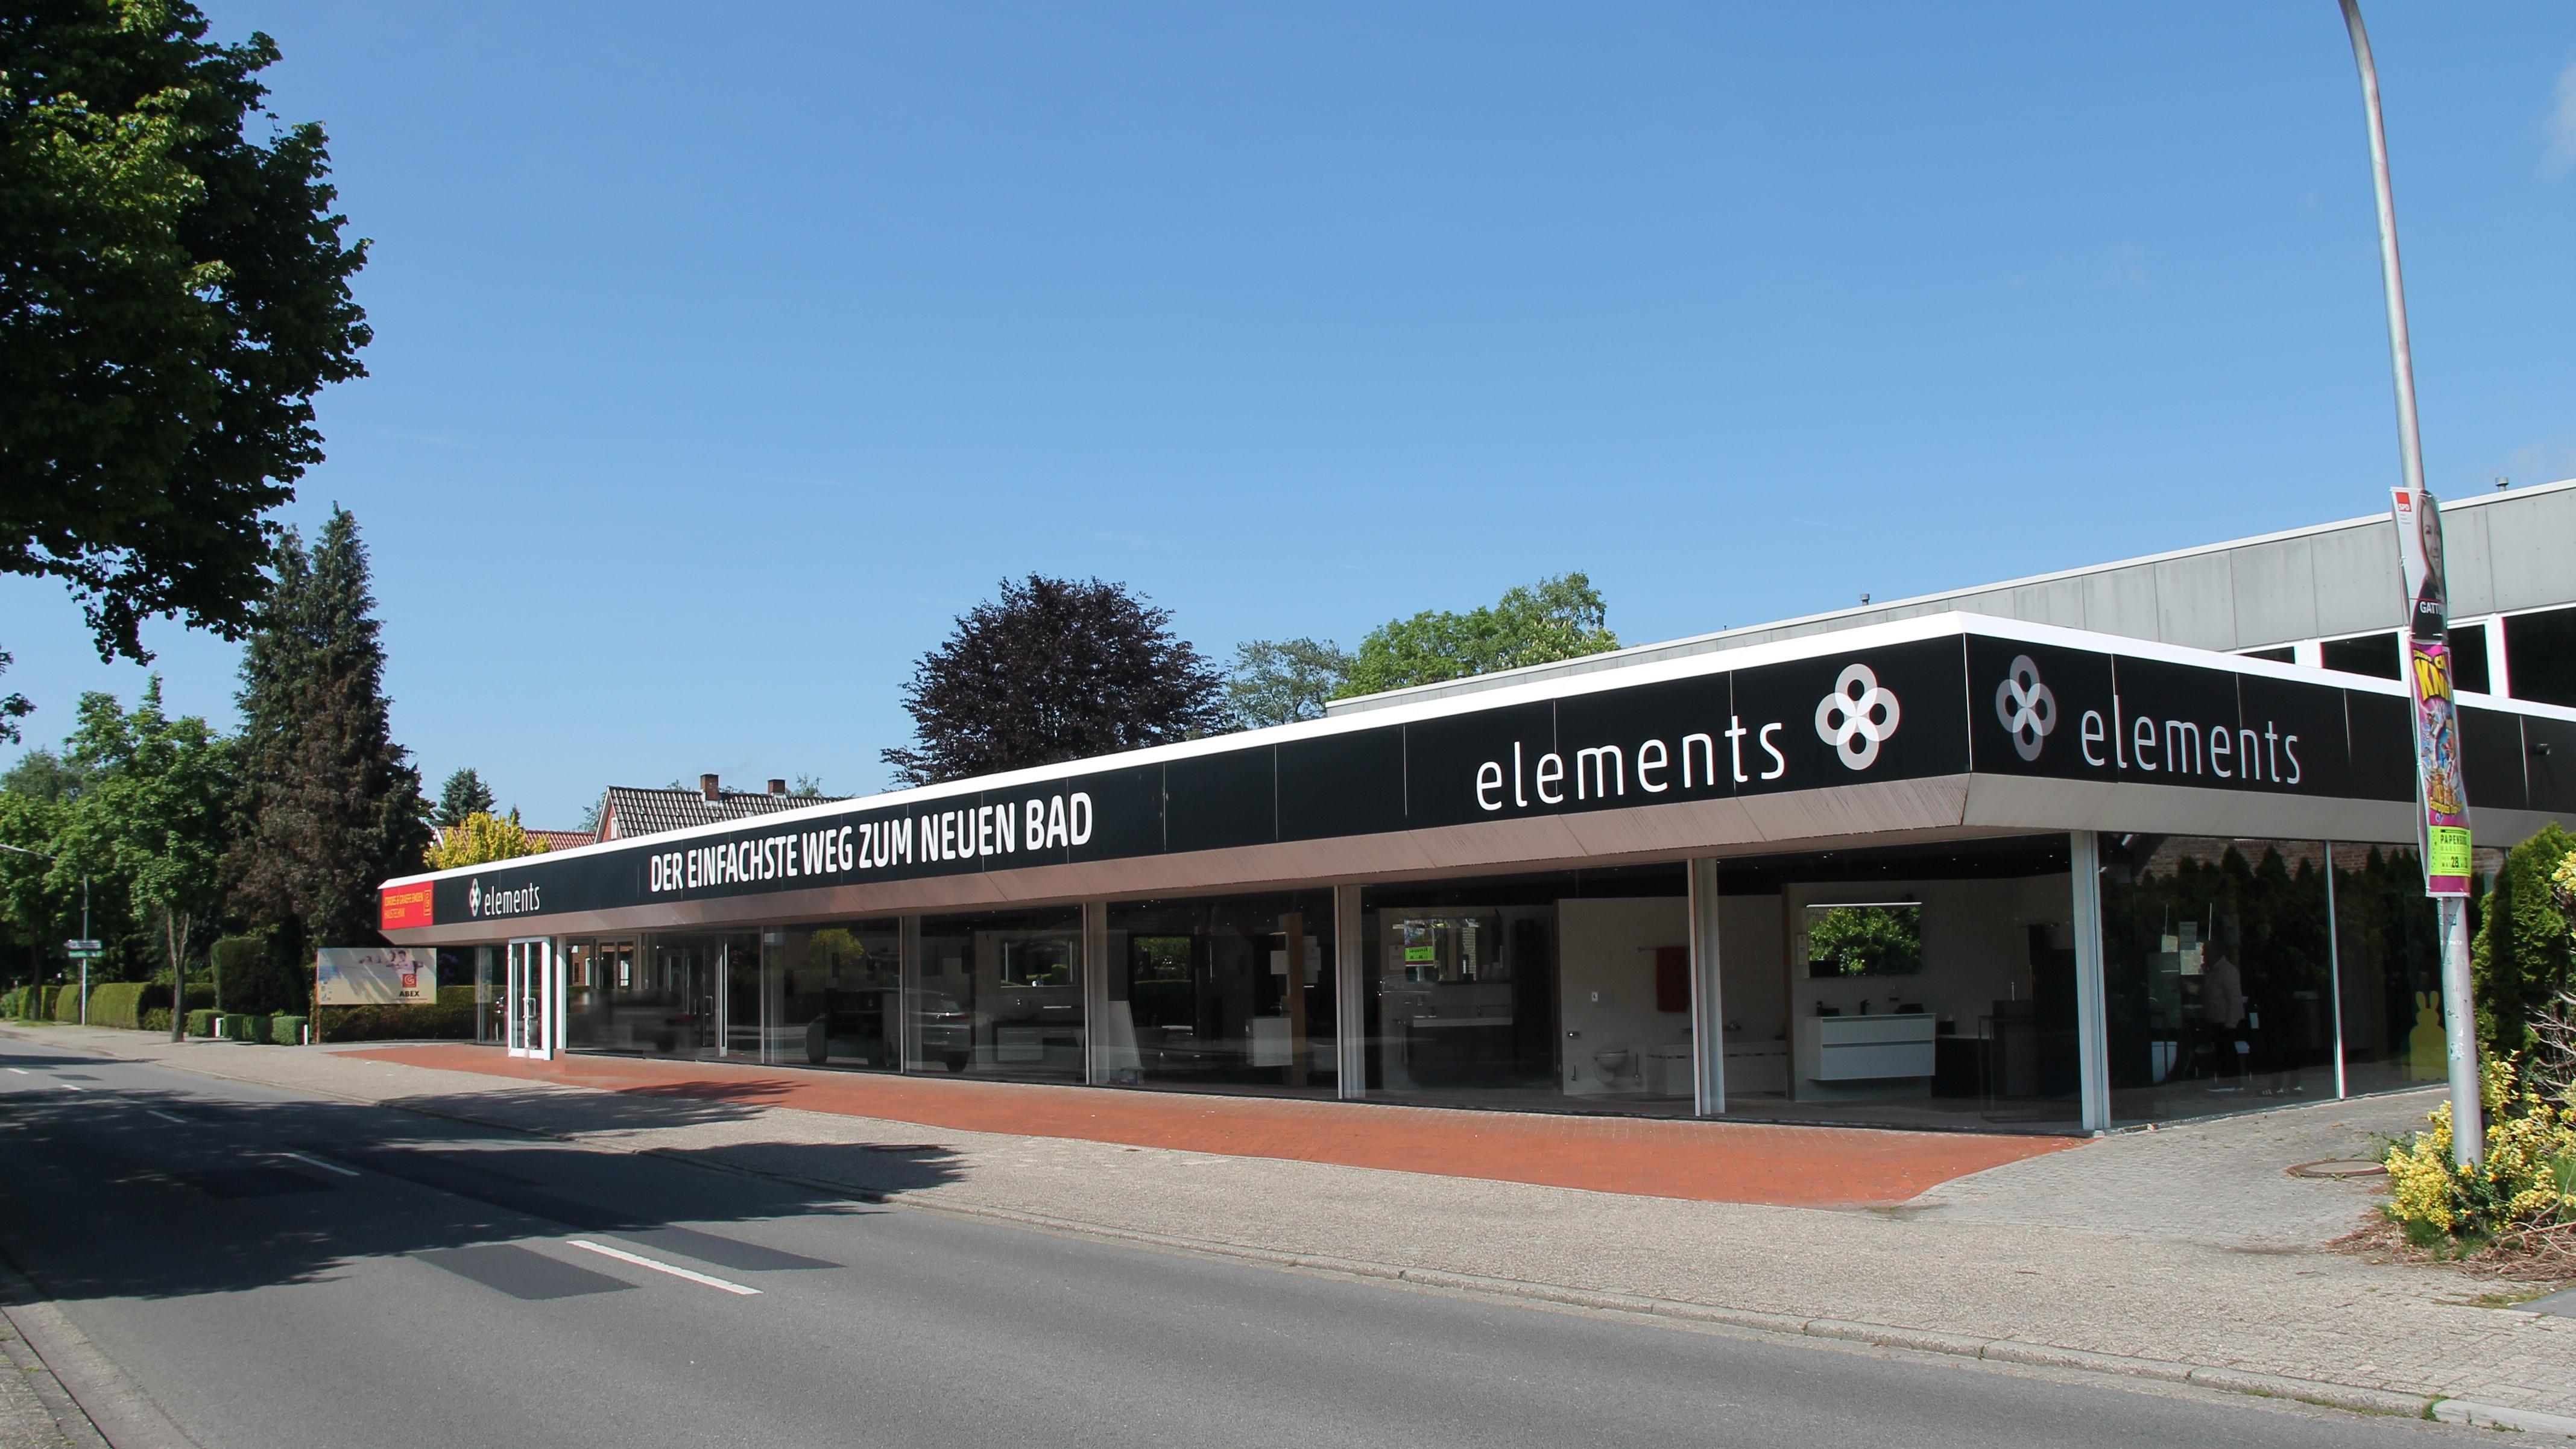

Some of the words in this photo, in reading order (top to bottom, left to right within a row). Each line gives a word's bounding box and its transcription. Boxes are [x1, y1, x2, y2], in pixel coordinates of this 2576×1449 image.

[2398, 503, 2410, 511] SPD
[1476, 715, 1785, 811] elements
[2081, 694, 2300, 784] elements
[651, 852, 683, 892] DER
[687, 834, 798, 888] EINFACHSTE
[802, 826, 853, 876] WEG
[859, 818, 912, 869] ZUM
[921, 802, 1015, 863] NEUEN
[1026, 792, 1093, 850] BAD
[484, 882, 540, 916] elements
